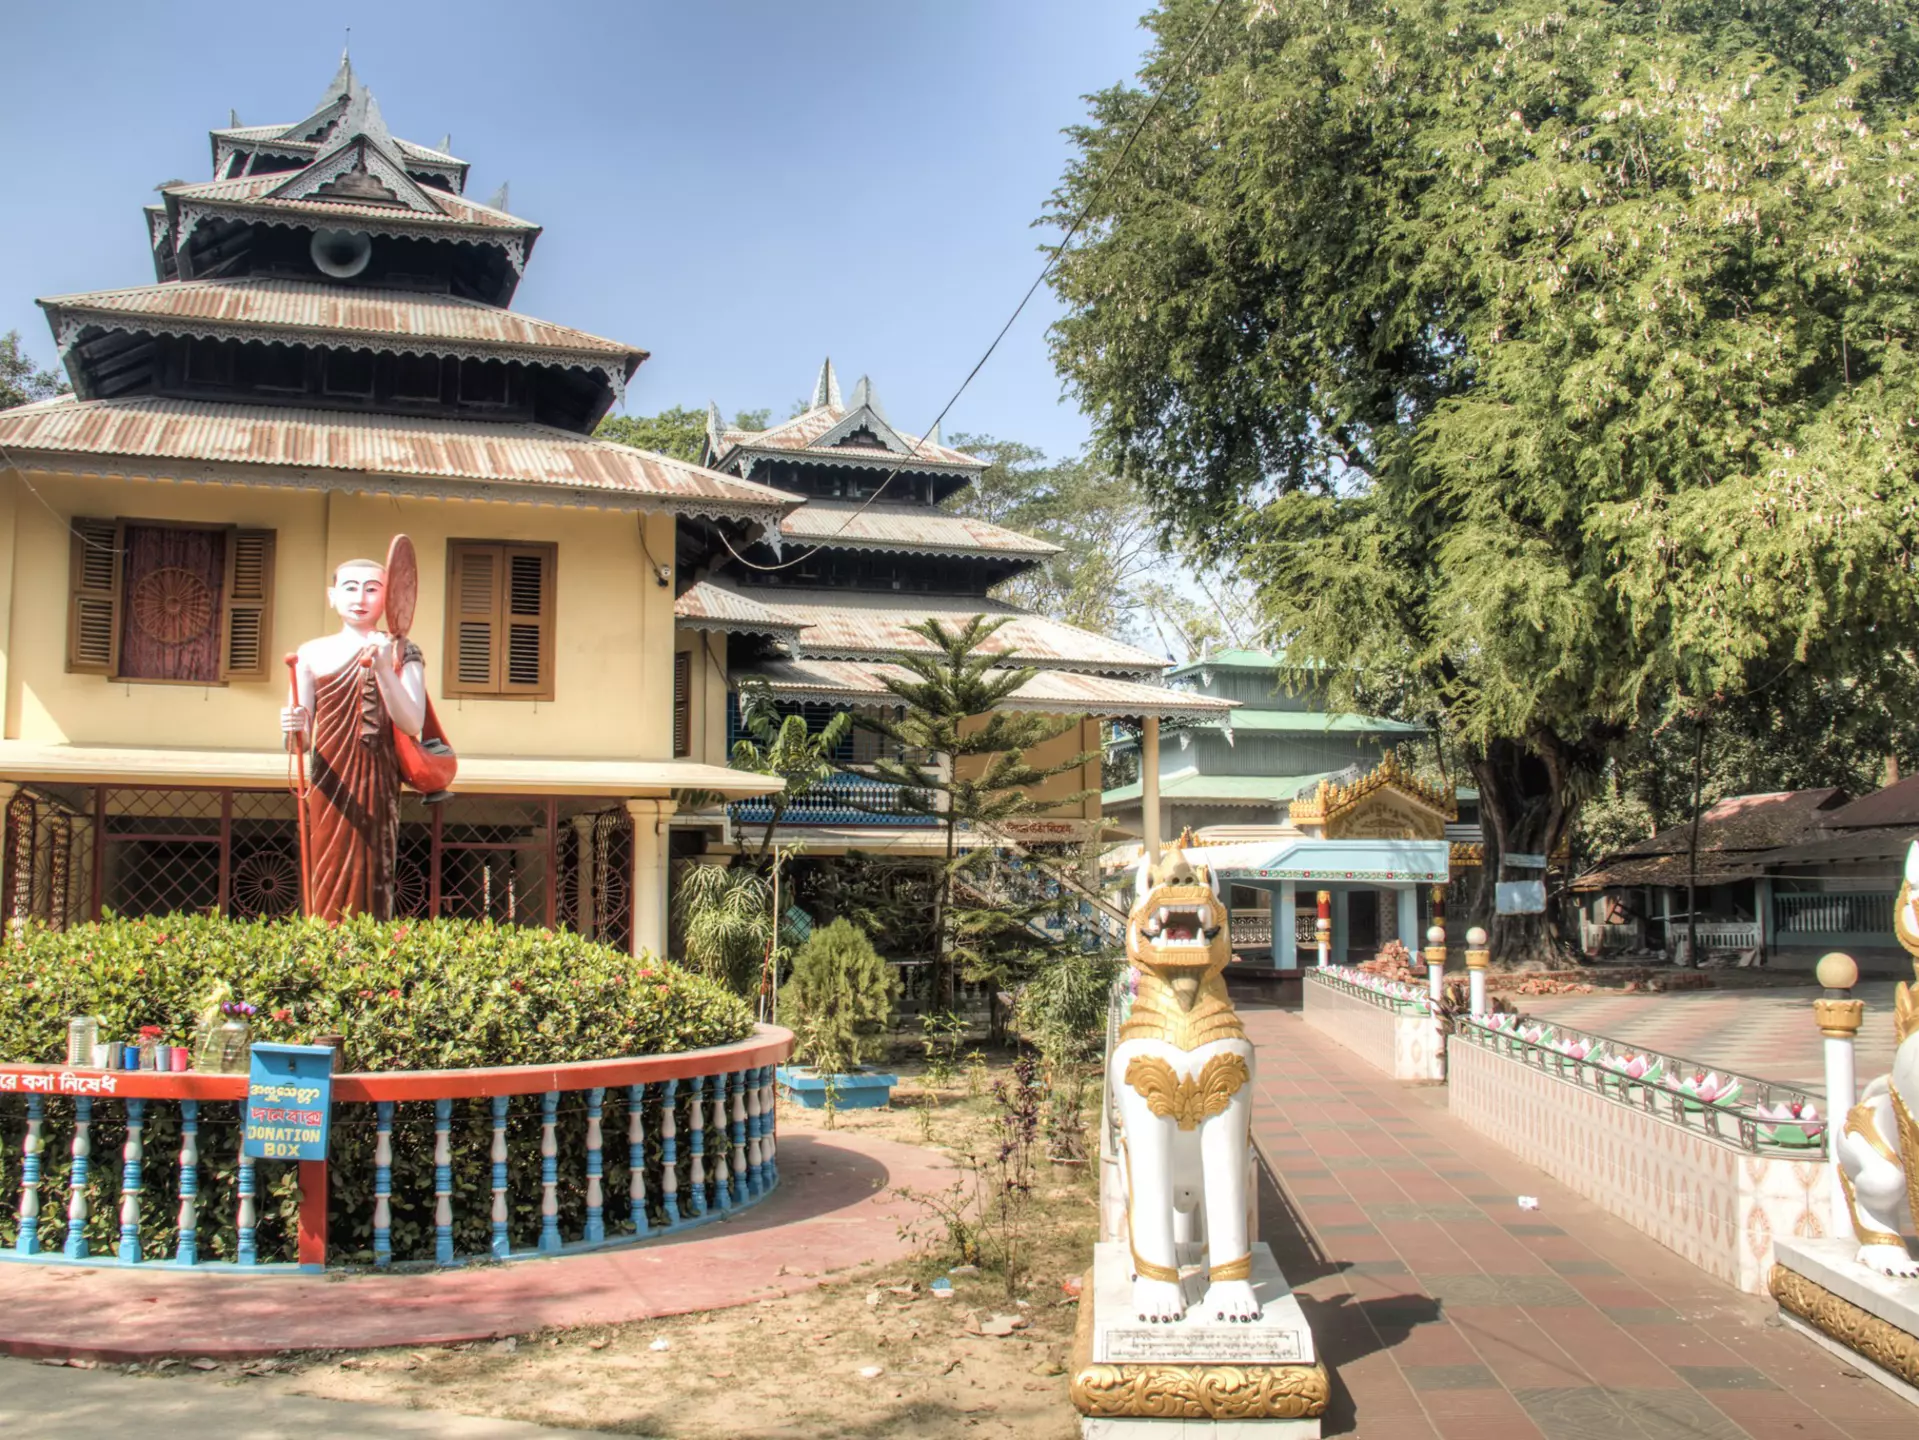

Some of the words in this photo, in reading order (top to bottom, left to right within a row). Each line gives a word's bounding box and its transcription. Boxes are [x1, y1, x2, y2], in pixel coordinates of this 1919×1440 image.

[21, 1074, 55, 1091] বসা
[58, 1071, 117, 1093] নিষেধ
[247, 1126, 321, 1143] DONATION
[264, 1142, 300, 1156] BOX
